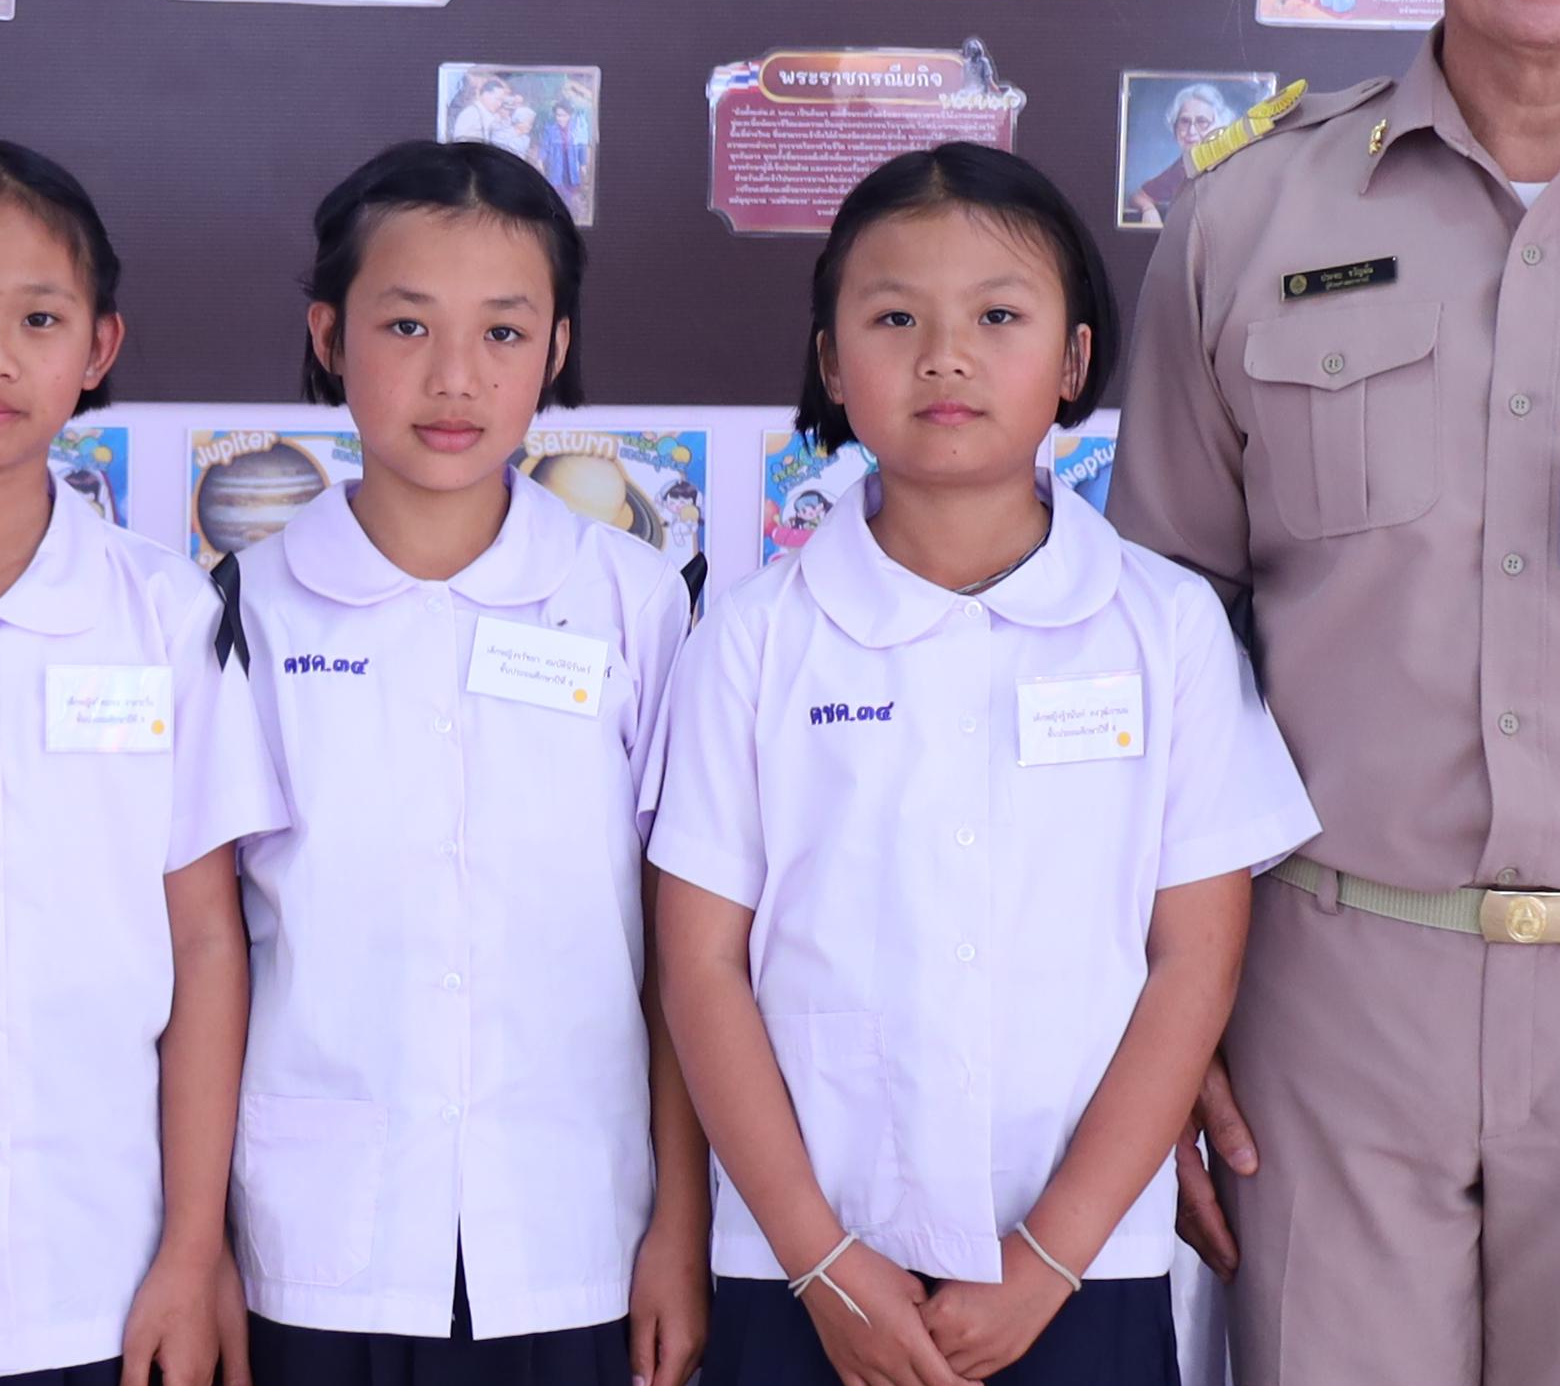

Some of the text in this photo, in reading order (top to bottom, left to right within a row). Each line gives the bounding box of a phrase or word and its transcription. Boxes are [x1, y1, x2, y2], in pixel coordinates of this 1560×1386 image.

[779, 63, 944, 89] พระราชกรณียกิจ
[196, 431, 277, 467] Jupiter
[283, 653, 370, 675] ตชด.๓๔
[809, 700, 895, 726] ตชด.๓๔
